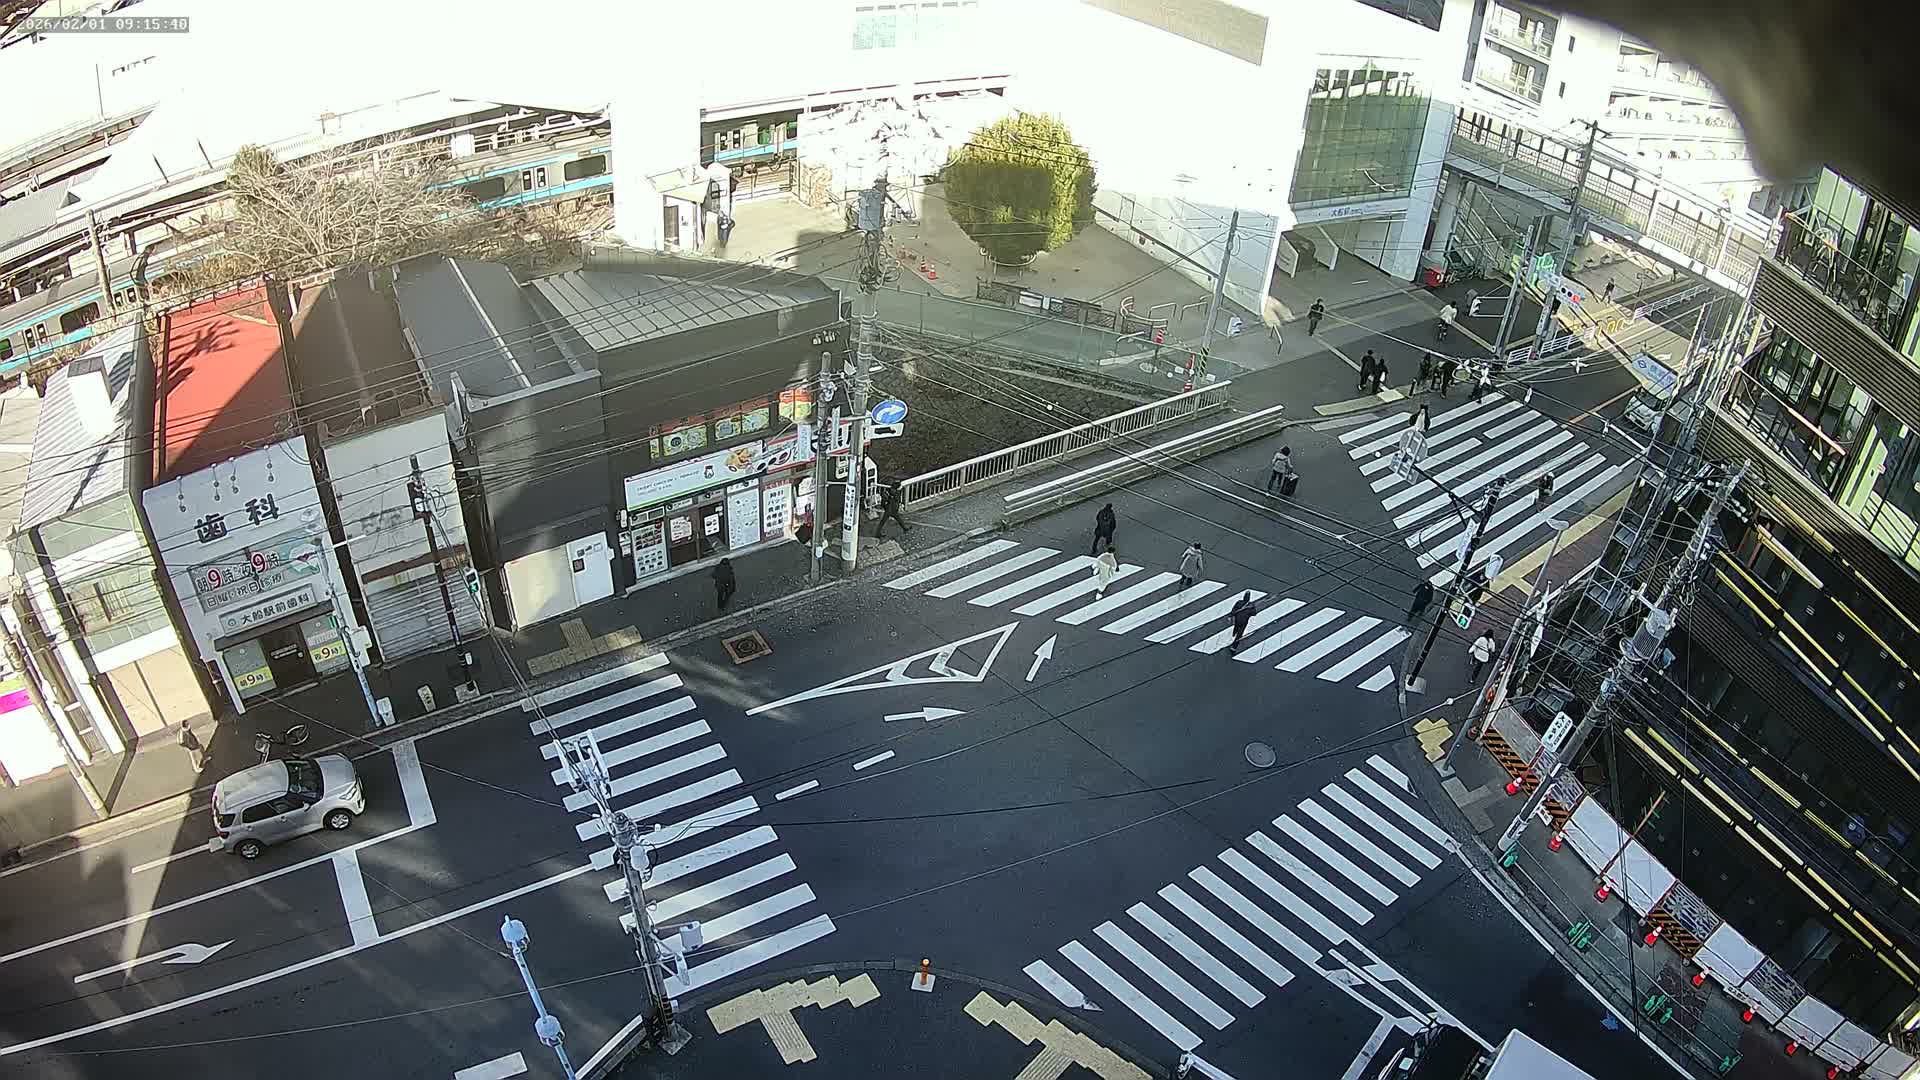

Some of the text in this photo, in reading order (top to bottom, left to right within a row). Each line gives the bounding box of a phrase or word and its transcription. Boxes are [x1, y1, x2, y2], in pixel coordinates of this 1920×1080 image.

[194, 493, 279, 543] 歯科
[241, 592, 309, 625] 大船駅前歯科
